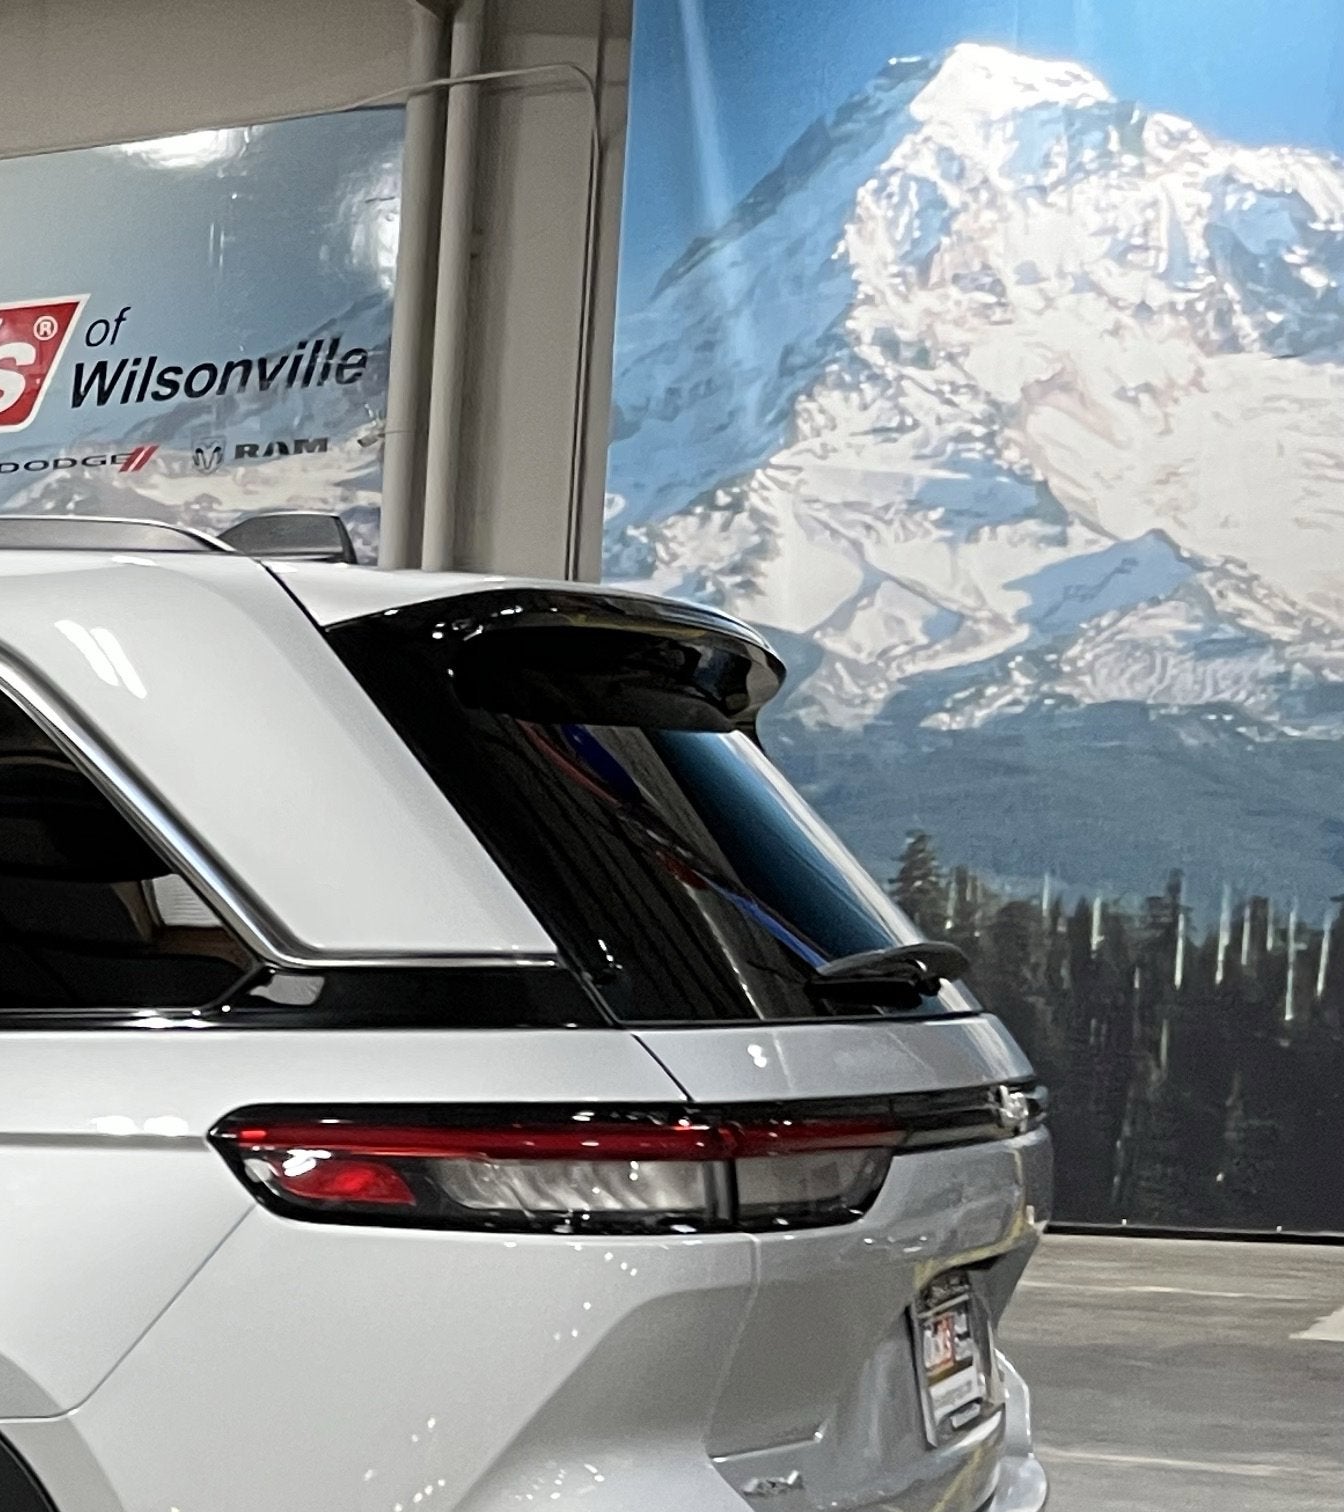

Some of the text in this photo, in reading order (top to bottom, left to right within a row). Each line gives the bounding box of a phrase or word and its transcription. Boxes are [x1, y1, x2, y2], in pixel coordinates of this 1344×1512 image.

[84, 306, 132, 347] of
[70, 335, 369, 409] Wilsonville
[234, 438, 329, 460] RAM
